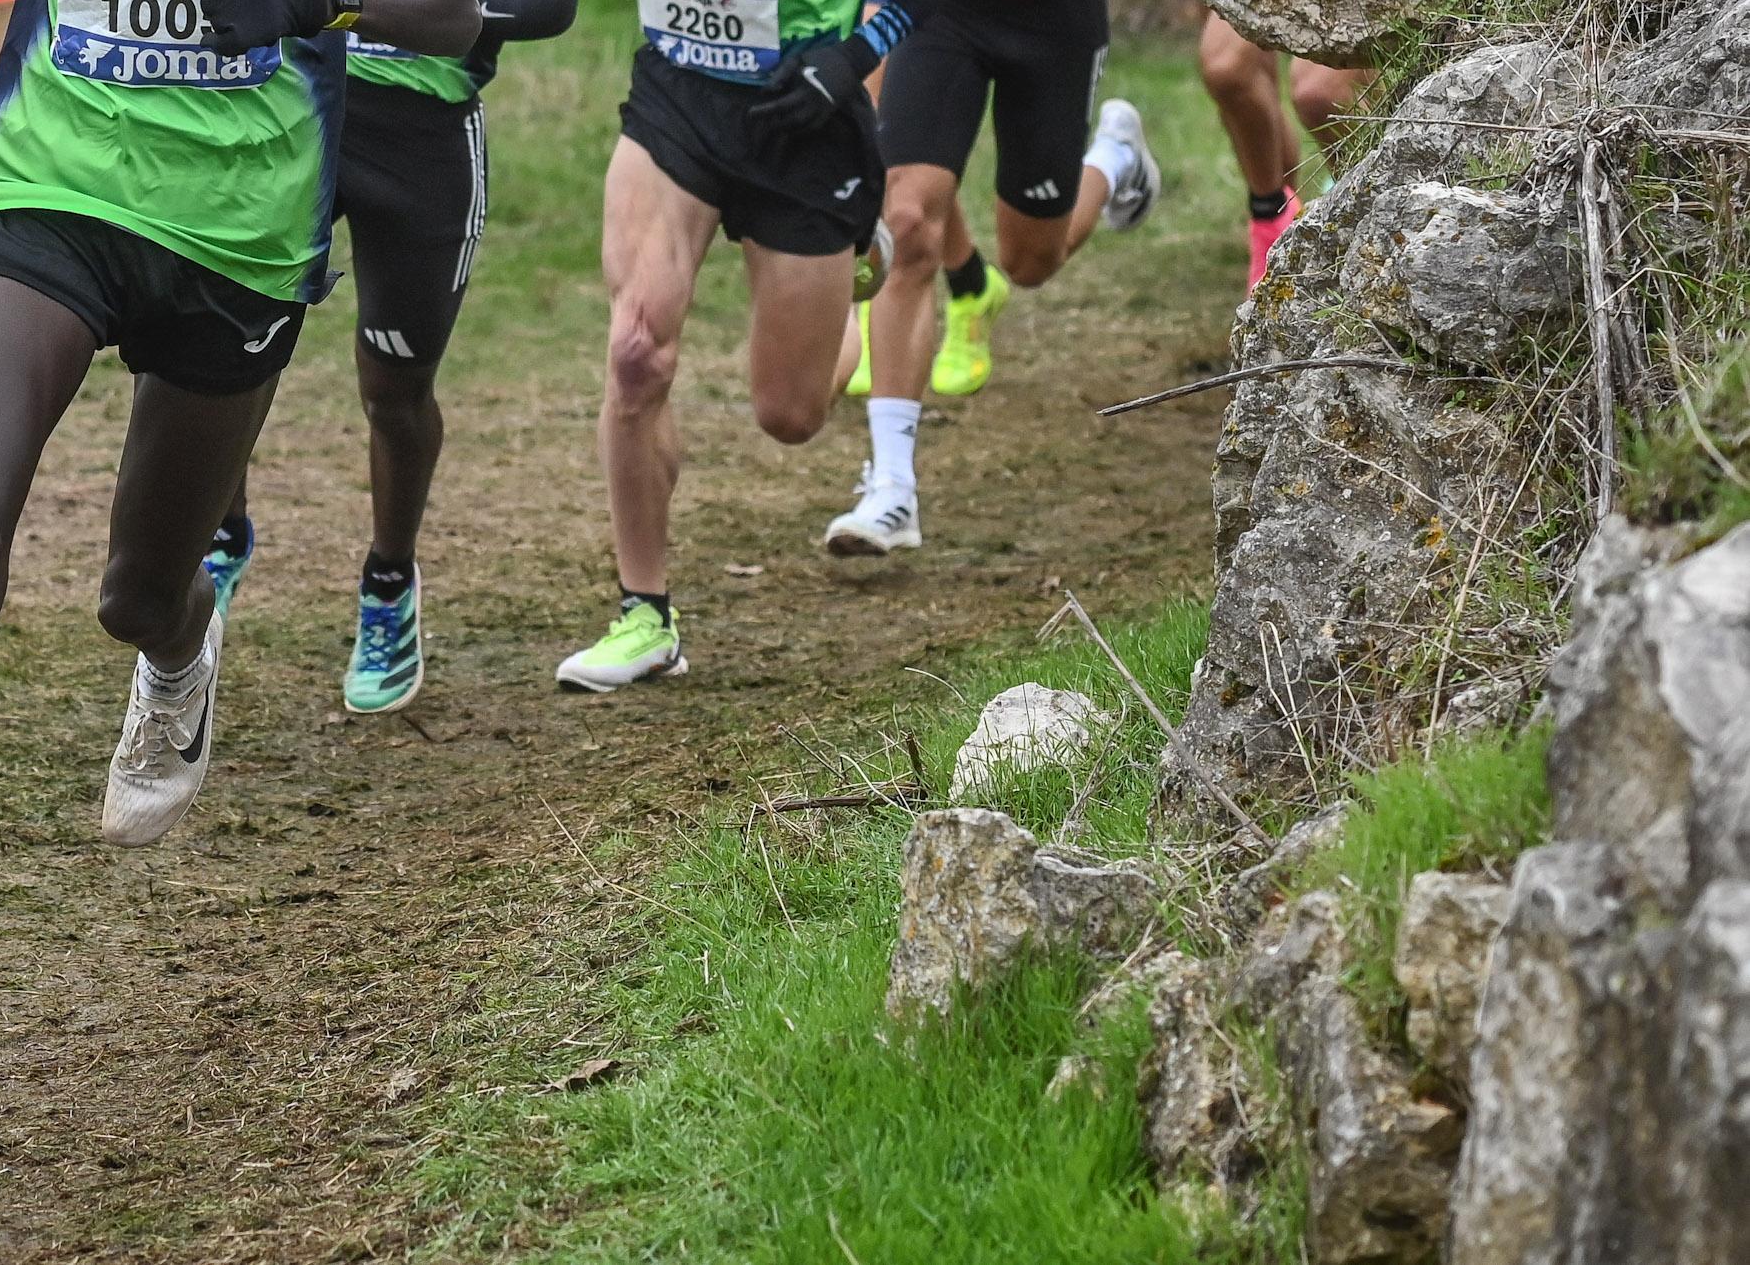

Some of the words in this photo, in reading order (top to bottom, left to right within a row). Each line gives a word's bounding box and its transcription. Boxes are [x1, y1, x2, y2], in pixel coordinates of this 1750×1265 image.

[666, 2, 744, 41] 2260
[112, 45, 252, 81] Joma
[676, 38, 760, 72] Joma
